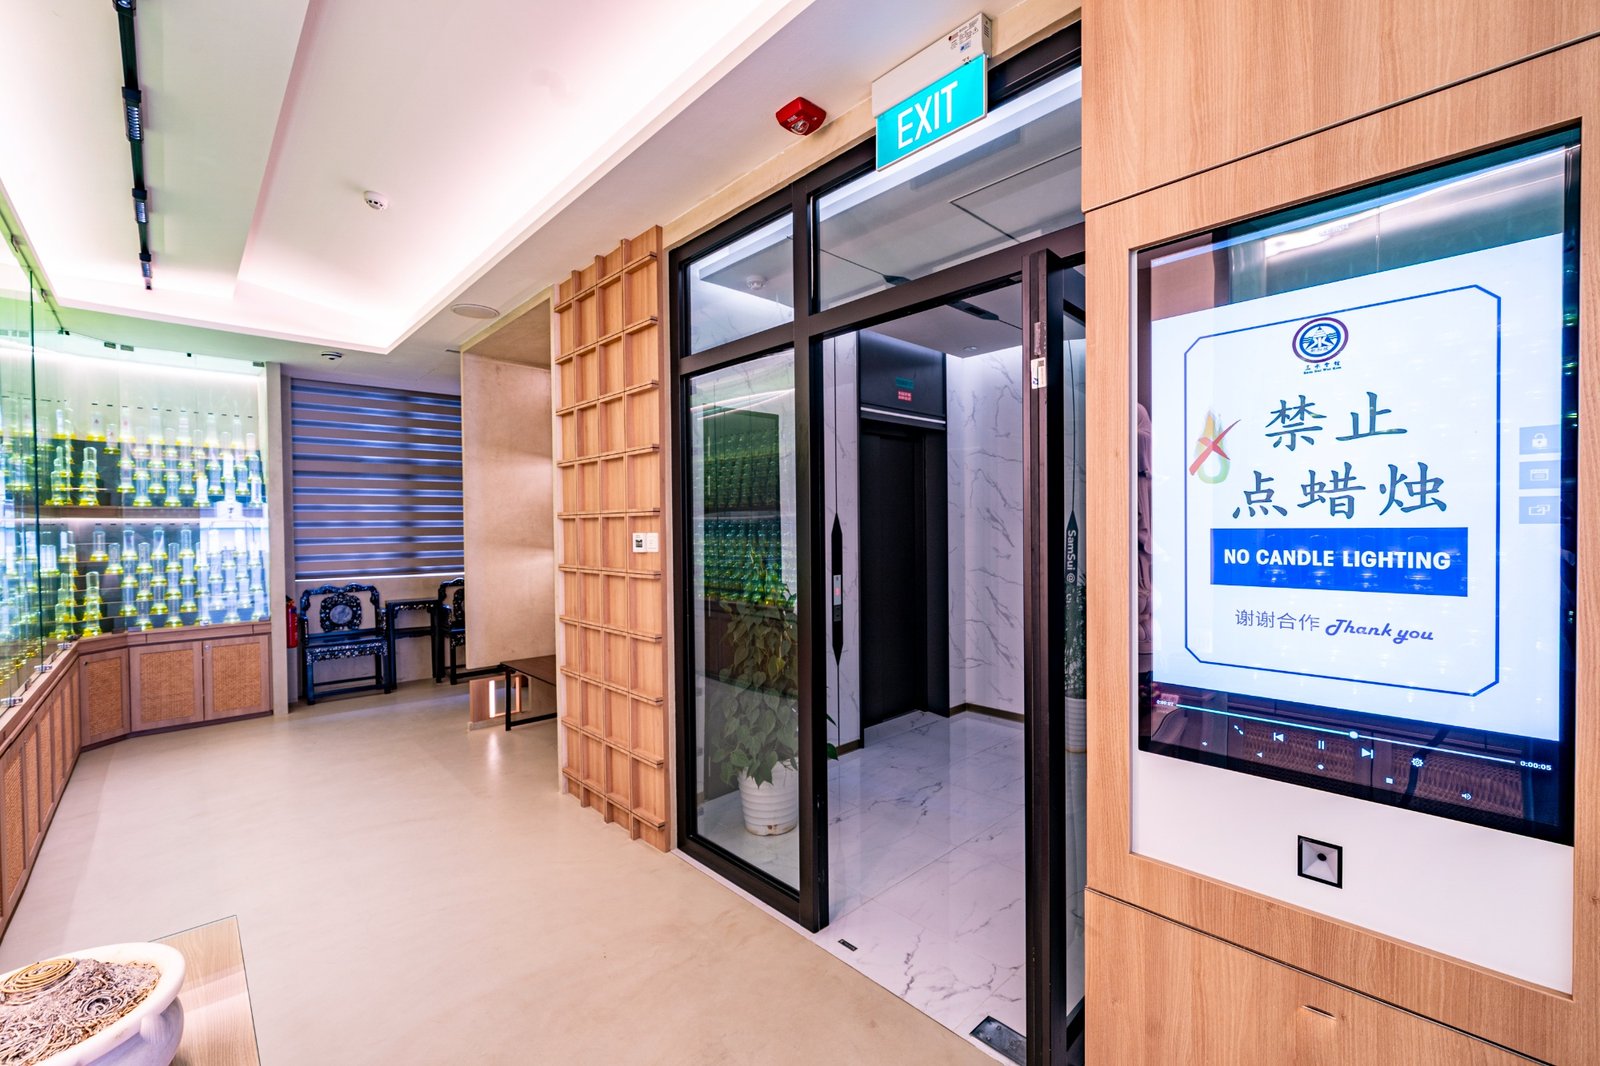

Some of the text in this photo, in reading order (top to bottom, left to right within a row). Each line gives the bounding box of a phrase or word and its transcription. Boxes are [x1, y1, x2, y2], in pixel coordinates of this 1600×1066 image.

[897, 80, 959, 150] EXIT
[1264, 391, 1408, 451] 禁止
[1232, 461, 1448, 520] 点蜡烛
[1067, 529, 1077, 571] SamSui
[1223, 548, 1452, 571] NO CANDLE LIGHTING
[1234, 608, 1320, 632] 谢谢合作
[1325, 619, 1434, 645] Thank you
[1519, 760, 1552, 771] 0:00:05
